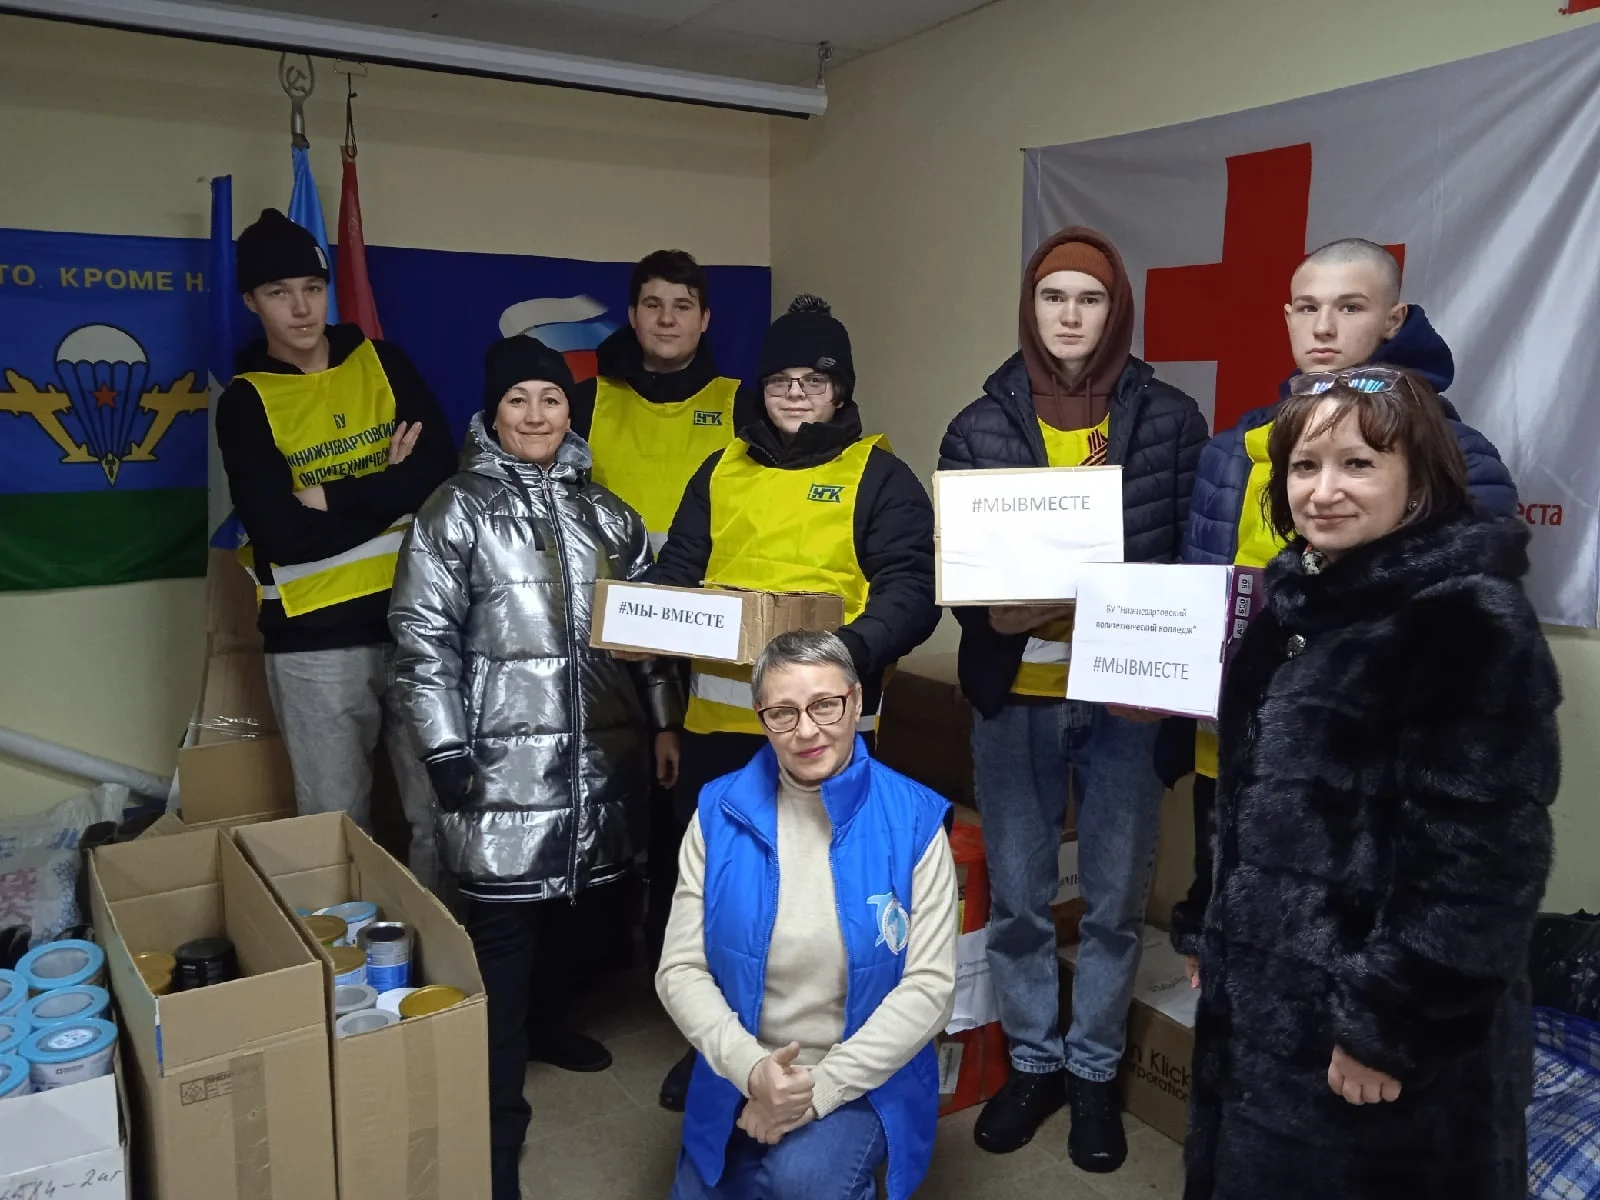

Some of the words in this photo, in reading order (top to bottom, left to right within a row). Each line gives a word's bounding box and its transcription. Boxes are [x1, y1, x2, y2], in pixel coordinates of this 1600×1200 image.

[60, 267, 174, 291] КРОМЕ
[333, 413, 346, 429] БУ
[972, 495, 1091, 513] #МЫВМЕСТЕ
[661, 607, 725, 629] ВМЕСТЕ
[1093, 656, 1189, 680] #МЫВМЕСТЕ
[1150, 1048, 1193, 1087] Klick
